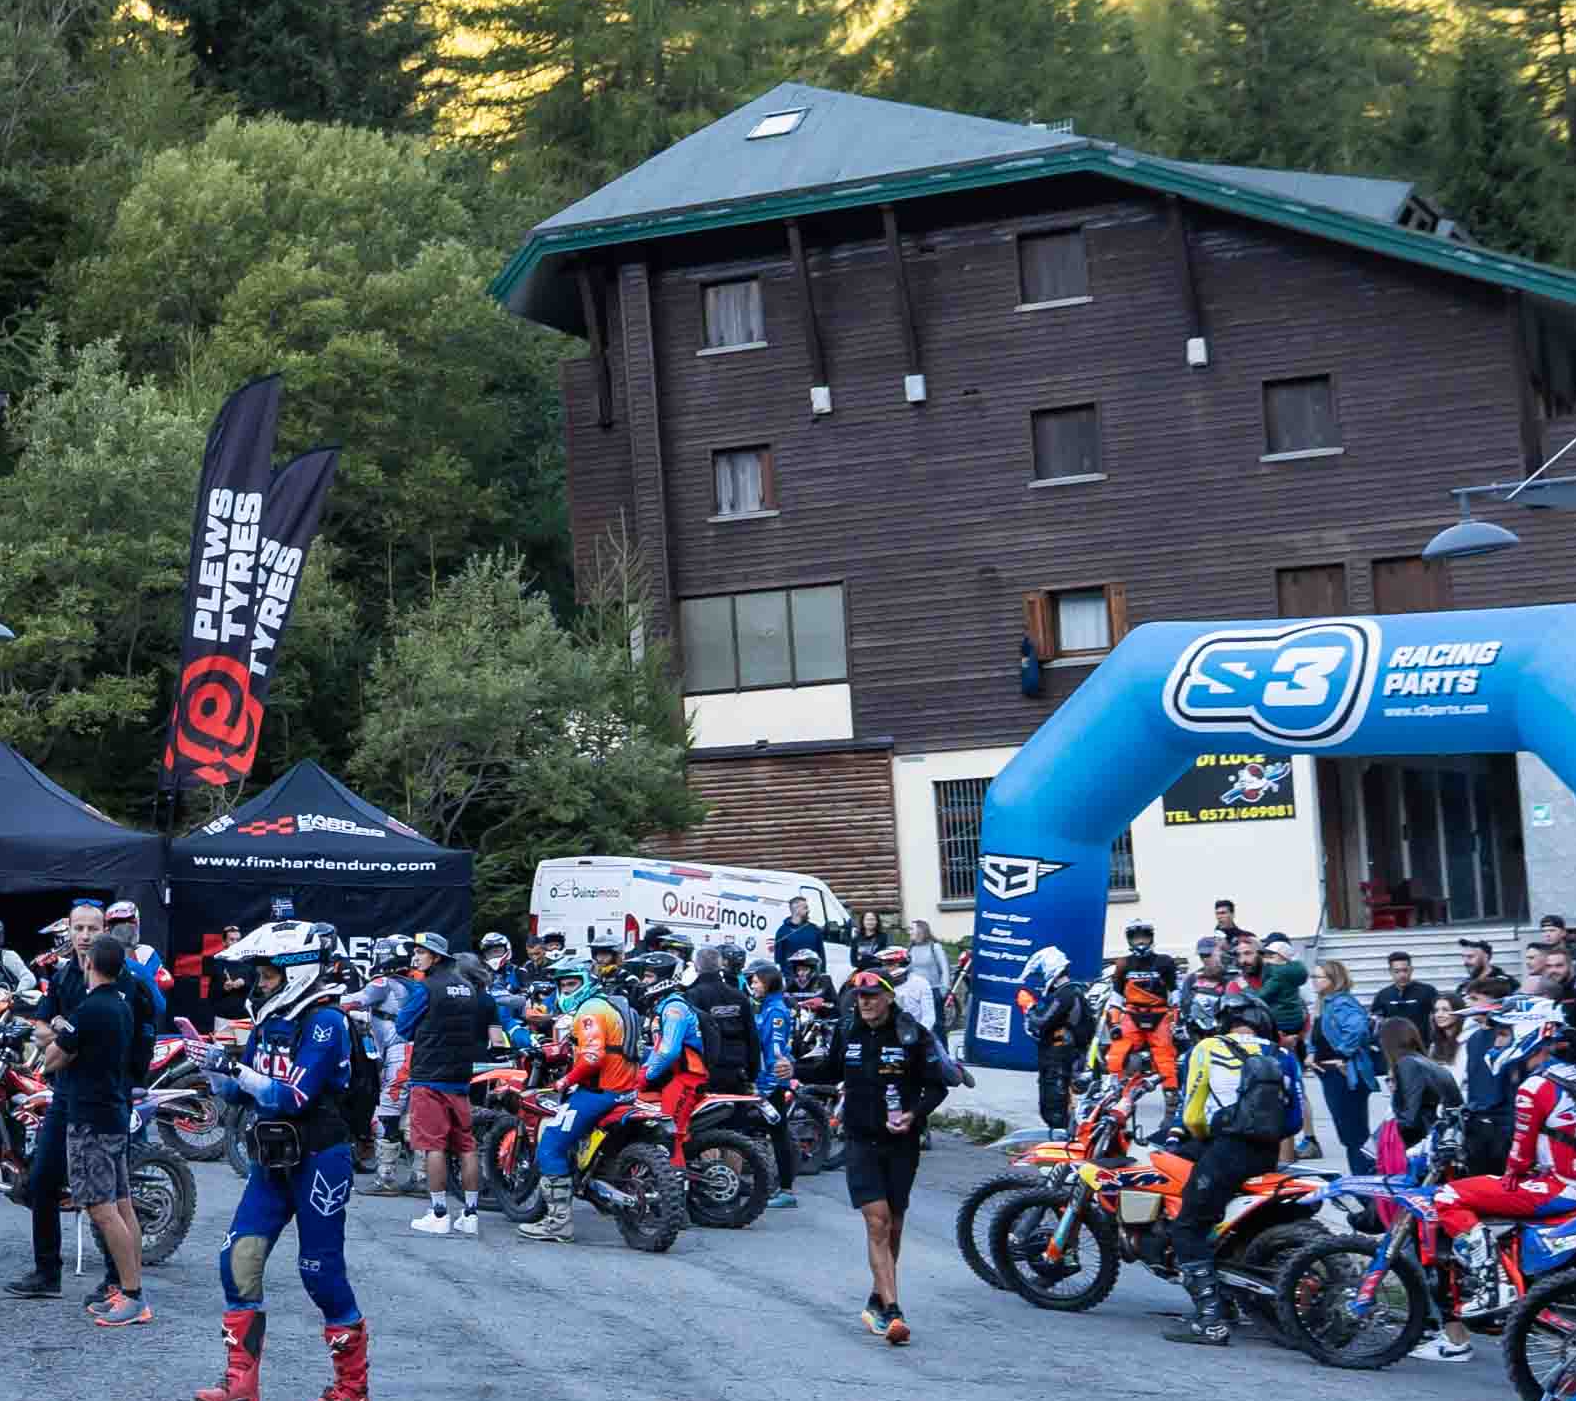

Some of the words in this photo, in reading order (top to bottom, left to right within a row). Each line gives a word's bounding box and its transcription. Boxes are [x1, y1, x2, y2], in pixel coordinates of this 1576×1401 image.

[192, 486, 234, 642] PLEWS
[221, 491, 263, 644] TYRES
[249, 544, 304, 678] TYRES
[1388, 641, 1502, 670] RACING
[1181, 644, 1347, 710] S3
[1383, 669, 1480, 698] PARTS
[1383, 703, 1489, 718] www.s3parts.com
[1164, 809, 1196, 824] TEL.
[1199, 803, 1295, 823] 0573/609081
[193, 855, 436, 872] www.fim-hardenduro.com
[662, 891, 768, 931] Quinzimoto
